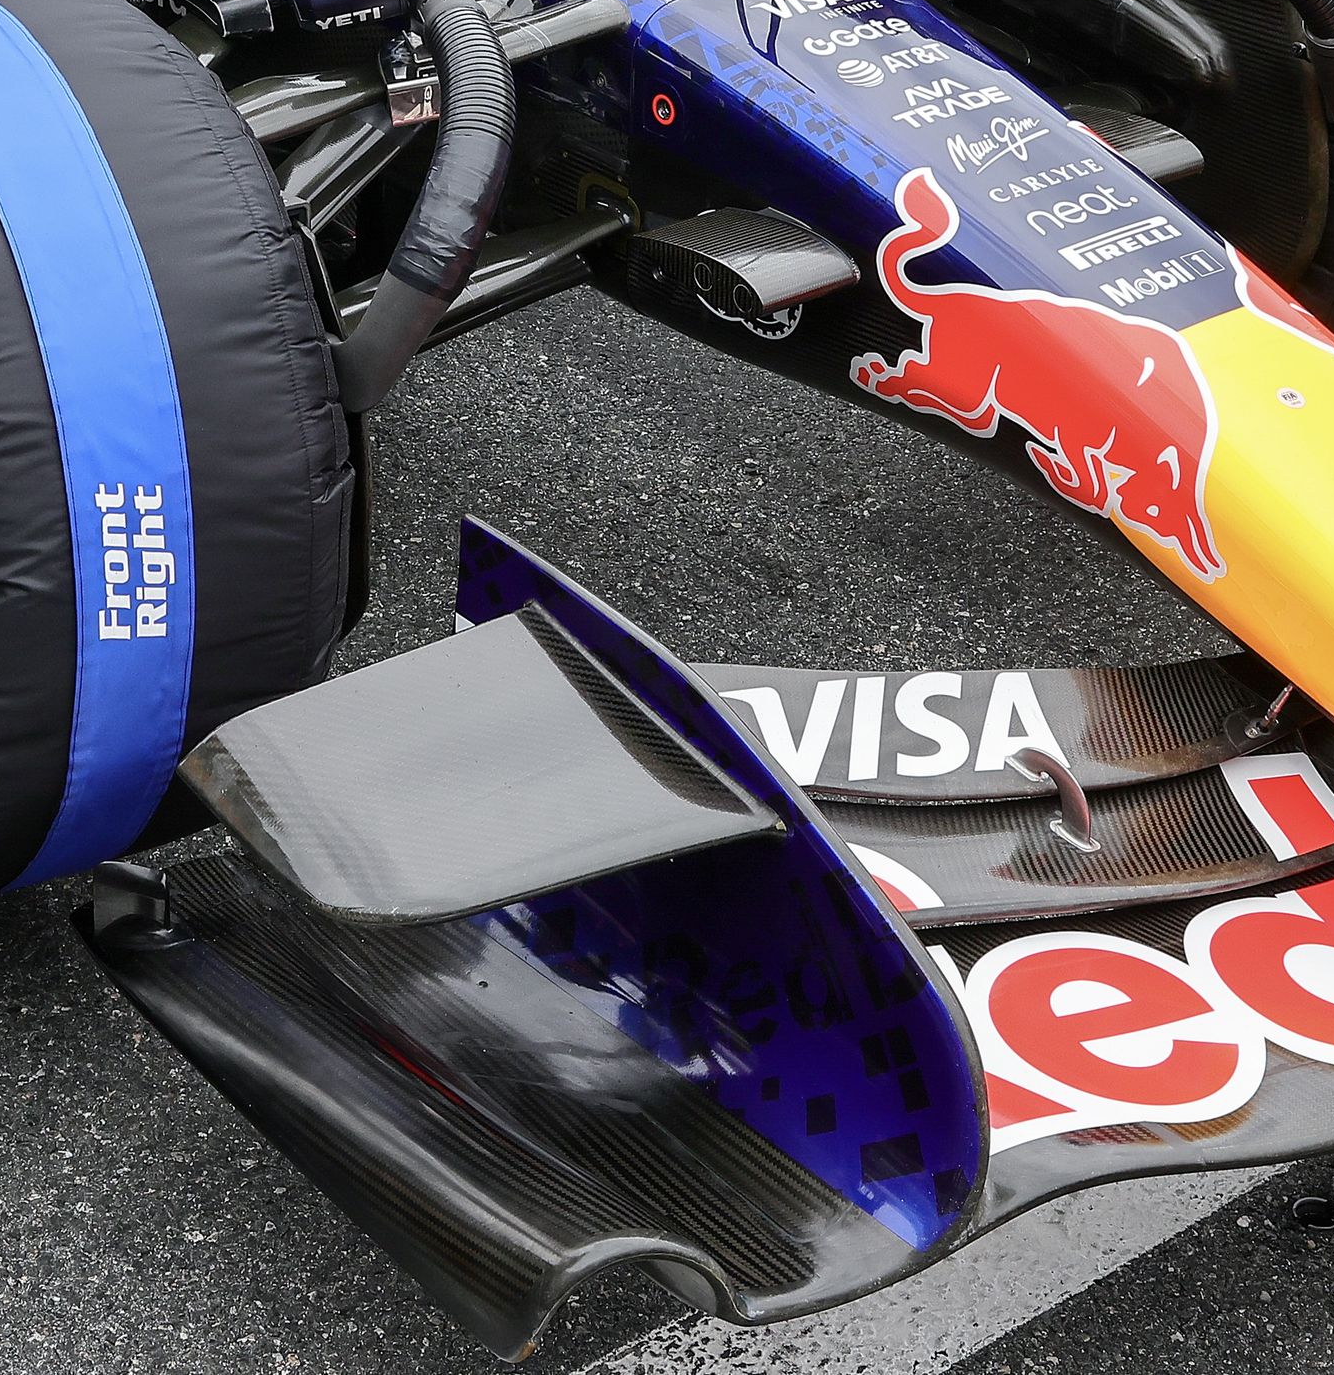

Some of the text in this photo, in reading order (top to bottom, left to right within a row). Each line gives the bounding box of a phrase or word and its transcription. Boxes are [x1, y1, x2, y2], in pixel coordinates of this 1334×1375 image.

[316, 5, 385, 31] YETI
[830, 13, 912, 51] Gate
[880, 40, 952, 75] AT&T
[892, 84, 1012, 128] TRADE
[904, 76, 970, 105] AVA
[946, 131, 994, 173] Maui
[988, 155, 1104, 205] CARLYLE
[1025, 184, 1138, 236] neat.
[1059, 215, 1183, 270] PIRELLI
[1098, 258, 1188, 308] Mobil
[1282, 391, 1298, 402] FIA
[98, 481, 132, 641] Front
[134, 484, 170, 640] Right
[720, 670, 1072, 789] VISA
